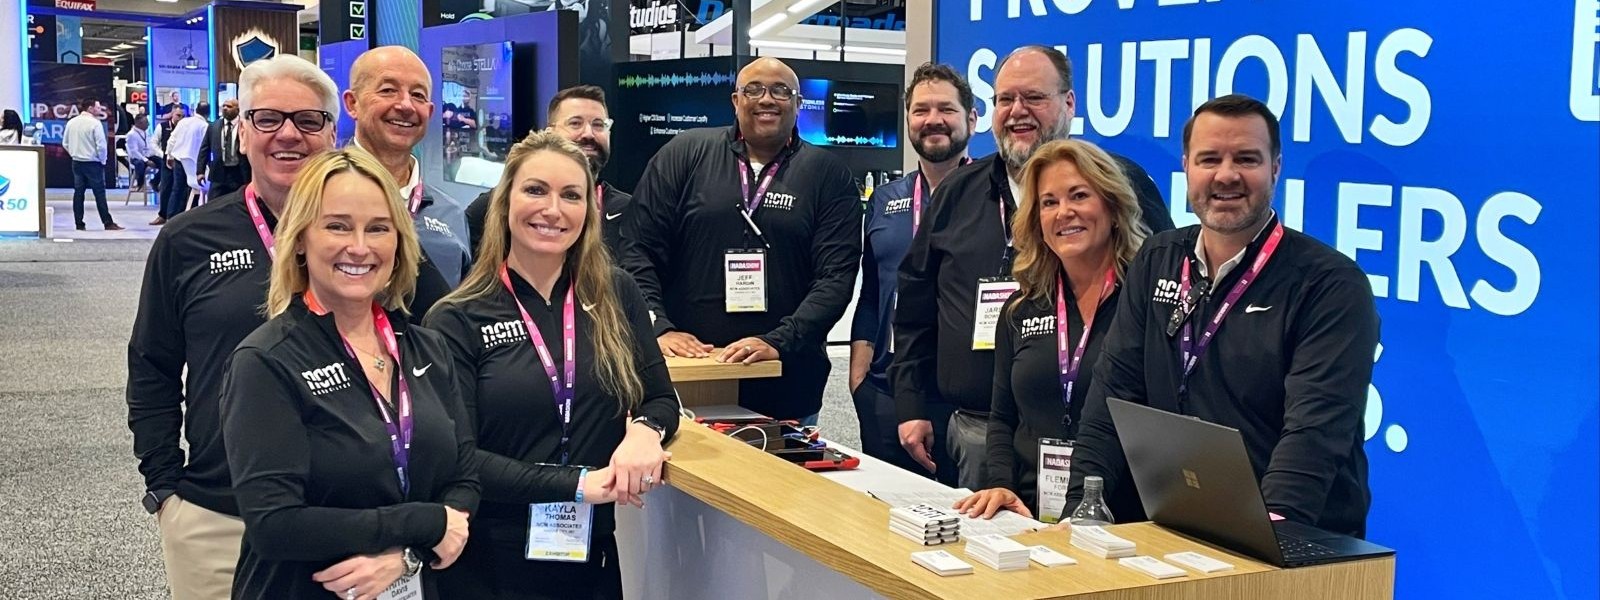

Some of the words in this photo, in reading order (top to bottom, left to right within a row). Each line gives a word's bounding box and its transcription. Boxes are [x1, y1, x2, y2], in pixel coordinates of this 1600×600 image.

[56, 0, 93, 11] EQUIFAX
[630, 0, 677, 28] tudios
[967, 27, 1434, 147] SUTIONS
[53, 103, 108, 120] CAS
[764, 192, 794, 207] ncm
[210, 249, 252, 269] ncm
[1154, 278, 1182, 299] nc
[481, 319, 525, 343] ncm
[1022, 315, 1055, 335] ncm
[302, 362, 348, 391] ncm
[1045, 457, 1070, 467] NADAS
[545, 504, 576, 514] KAYLA
[545, 513, 576, 521] THOMAS
[391, 585, 408, 598] DAVIS
